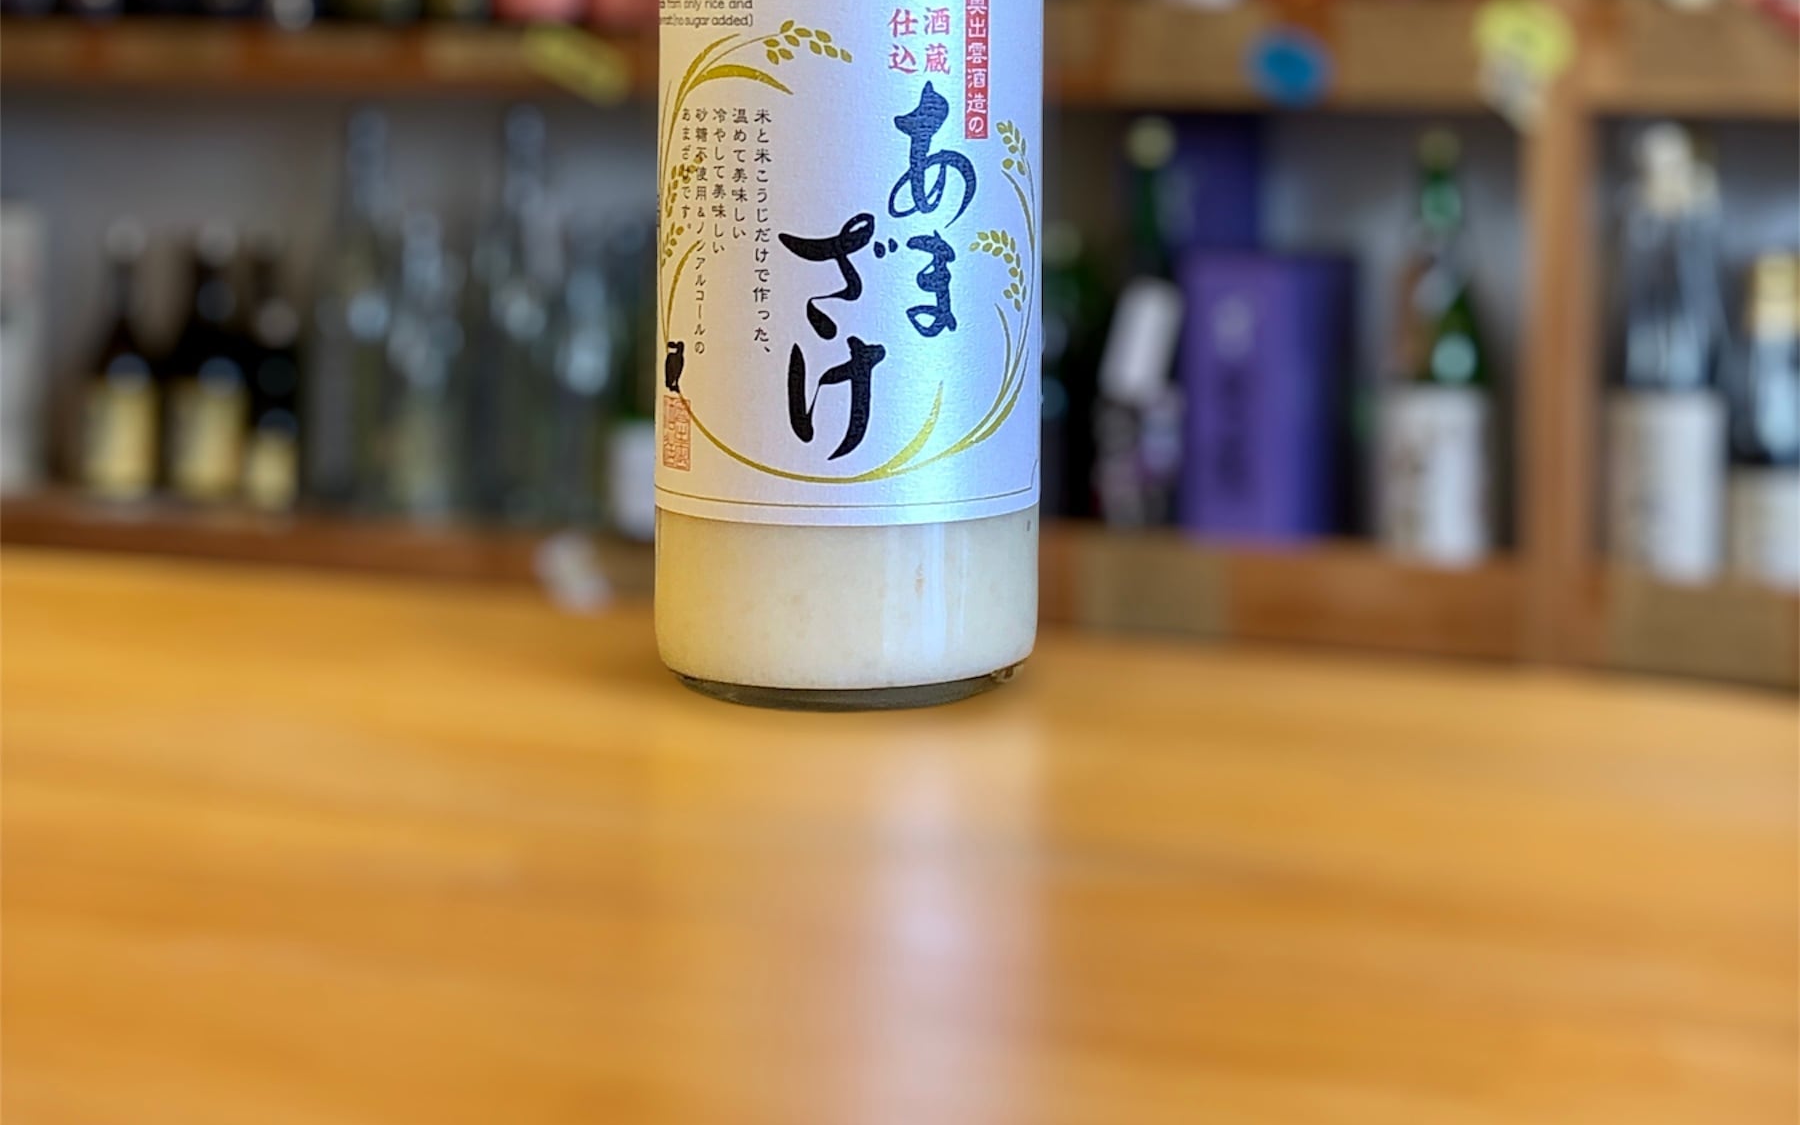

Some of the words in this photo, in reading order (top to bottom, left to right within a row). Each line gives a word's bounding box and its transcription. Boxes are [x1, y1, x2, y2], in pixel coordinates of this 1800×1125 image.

[711, 13, 753, 28] added)
[887, 7, 920, 75] 仕込
[923, 6, 952, 76] 酒蔵
[711, 107, 728, 254] 冷やして美味しい
[731, 107, 749, 240] 温めて美味しい
[753, 108, 773, 354] 米と米こうじだけで作った、
[887, 80, 978, 338] あま
